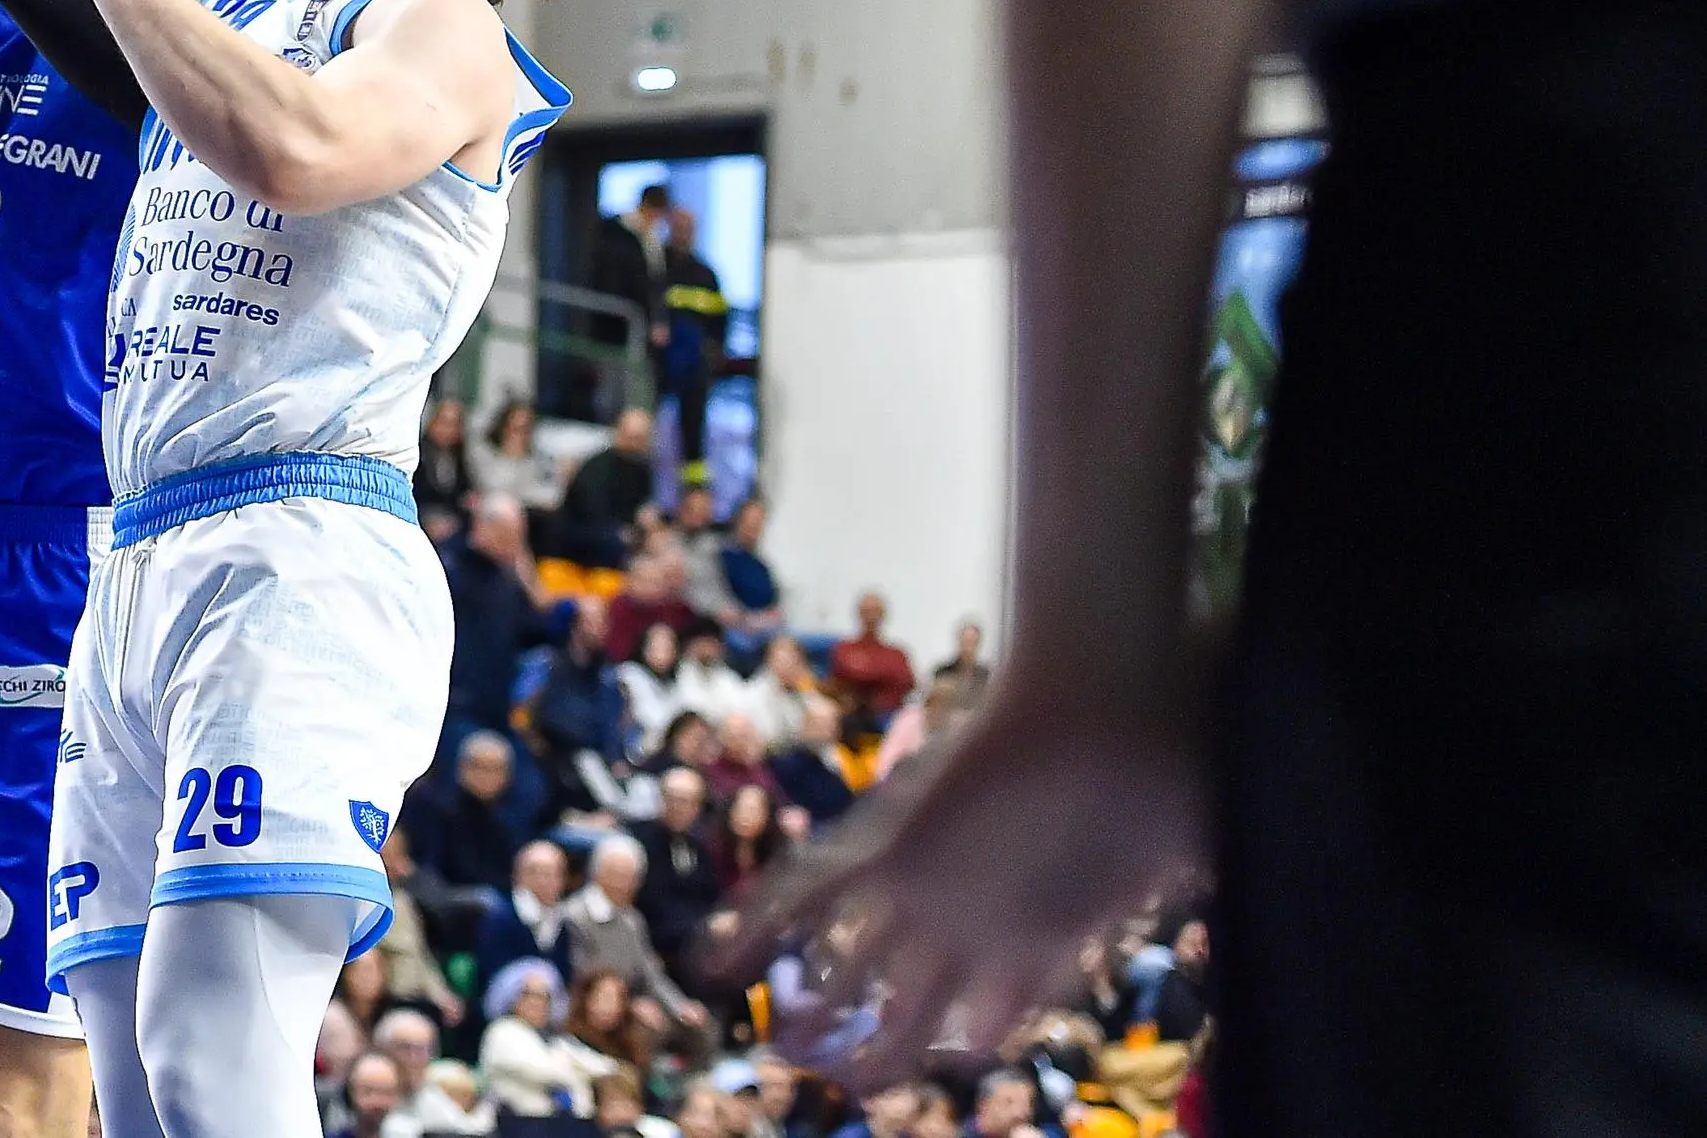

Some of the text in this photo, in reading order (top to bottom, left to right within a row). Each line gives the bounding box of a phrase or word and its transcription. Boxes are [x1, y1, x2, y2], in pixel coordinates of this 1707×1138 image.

[141, 186, 235, 227] Banco
[129, 230, 293, 288] Sardegna
[173, 292, 280, 326] sardares
[127, 324, 221, 358] REALE
[173, 764, 263, 854] 29
